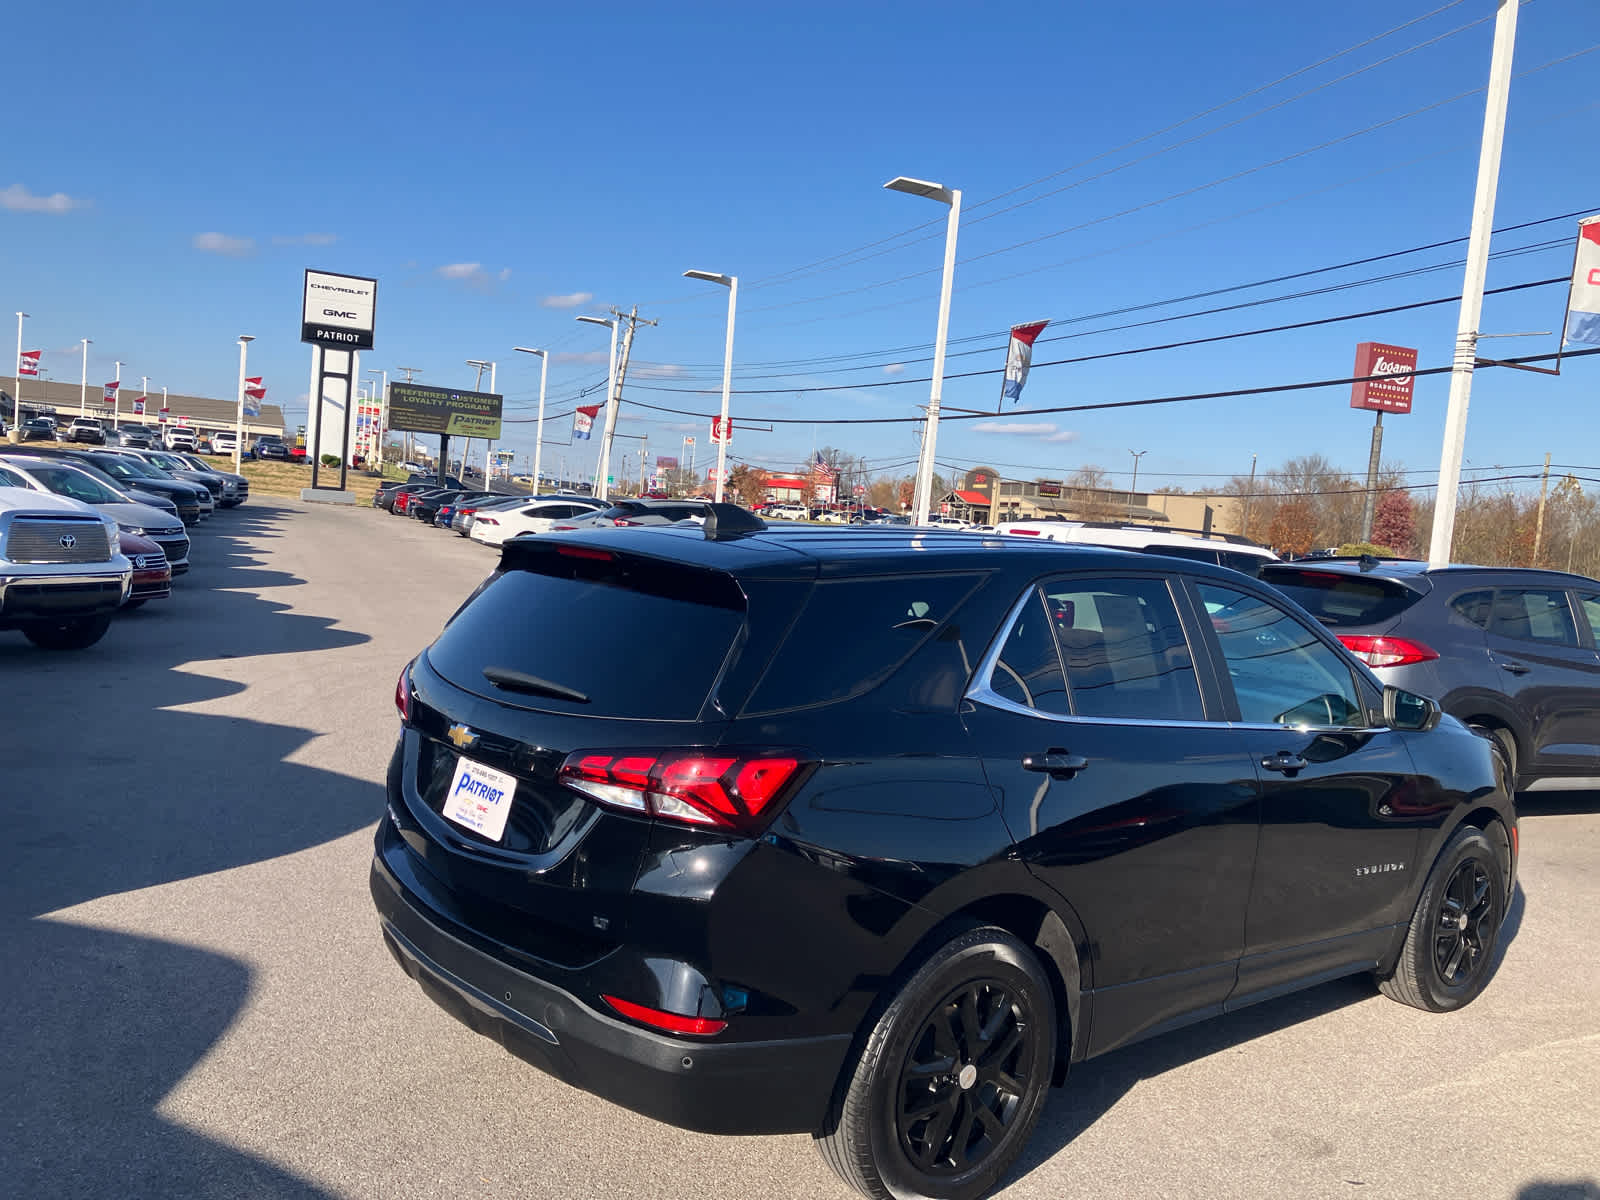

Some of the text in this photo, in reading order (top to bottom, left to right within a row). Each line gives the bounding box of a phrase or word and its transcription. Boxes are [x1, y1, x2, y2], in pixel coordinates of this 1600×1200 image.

[310, 283, 369, 295] CHEVROLET
[323, 309, 357, 319] GMC
[316, 330, 360, 343] PATRIOT
[393, 387, 499, 406] PREFERRED CUSTOMER
[403, 396, 490, 411] LOYALTY PROGRAM
[453, 415, 497, 426] PATRIOT
[455, 772, 504, 805] PATRIOT
